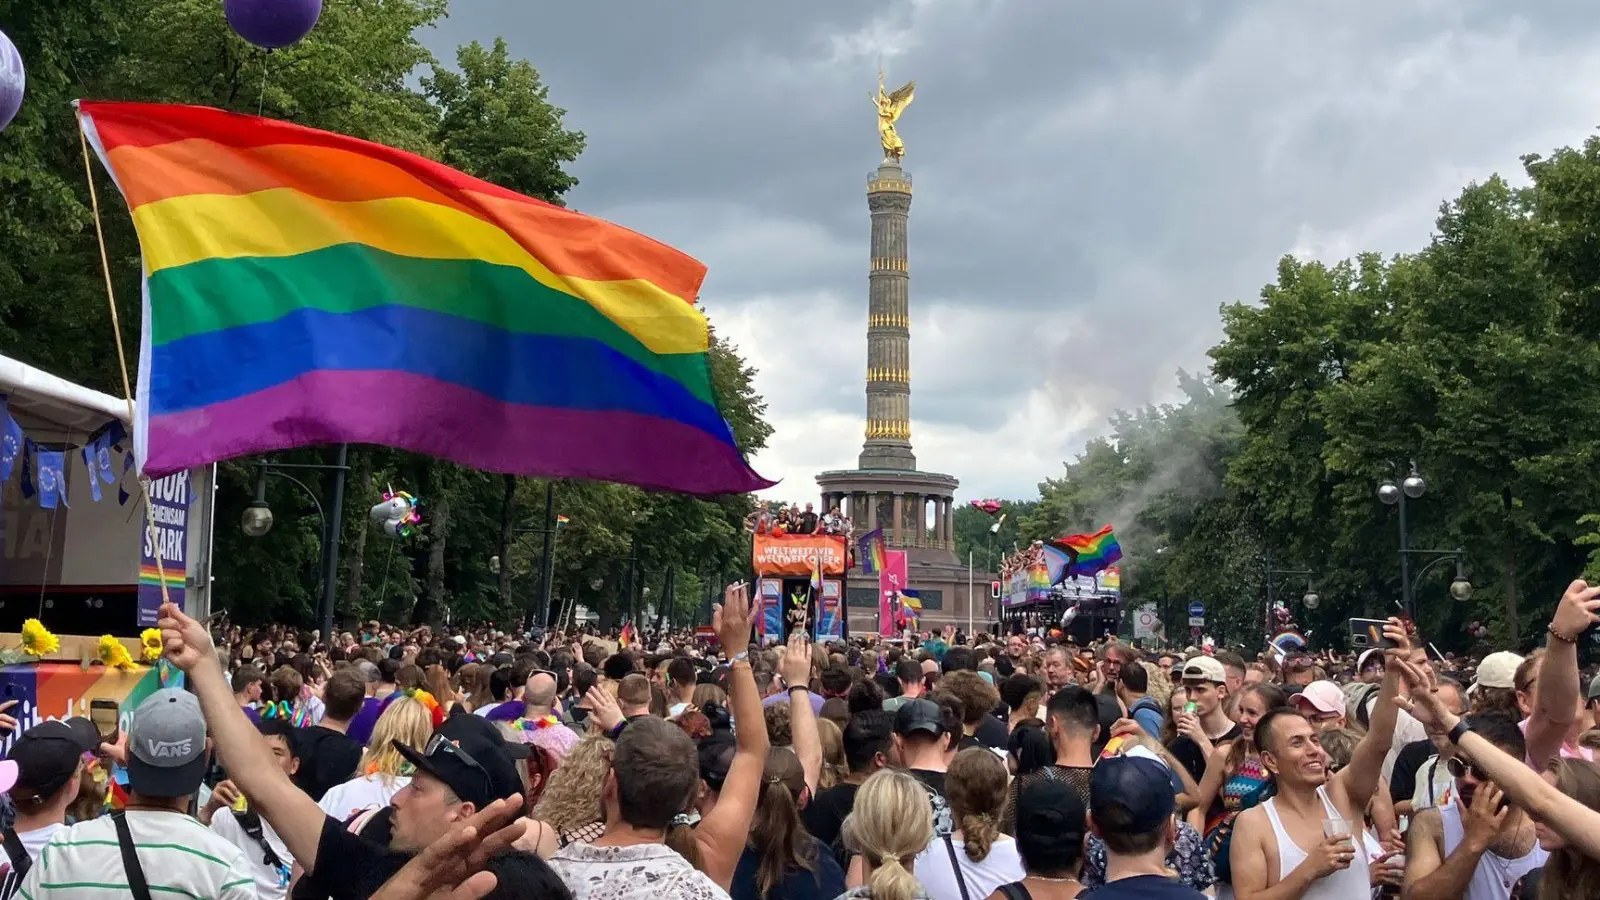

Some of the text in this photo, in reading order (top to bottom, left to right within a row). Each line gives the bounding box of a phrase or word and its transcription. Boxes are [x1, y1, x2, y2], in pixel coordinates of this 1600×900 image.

[764, 547, 833, 555] WELTWEIT WIR
[757, 555, 807, 563] WELTWEIT
[148, 738, 192, 757] VANS
